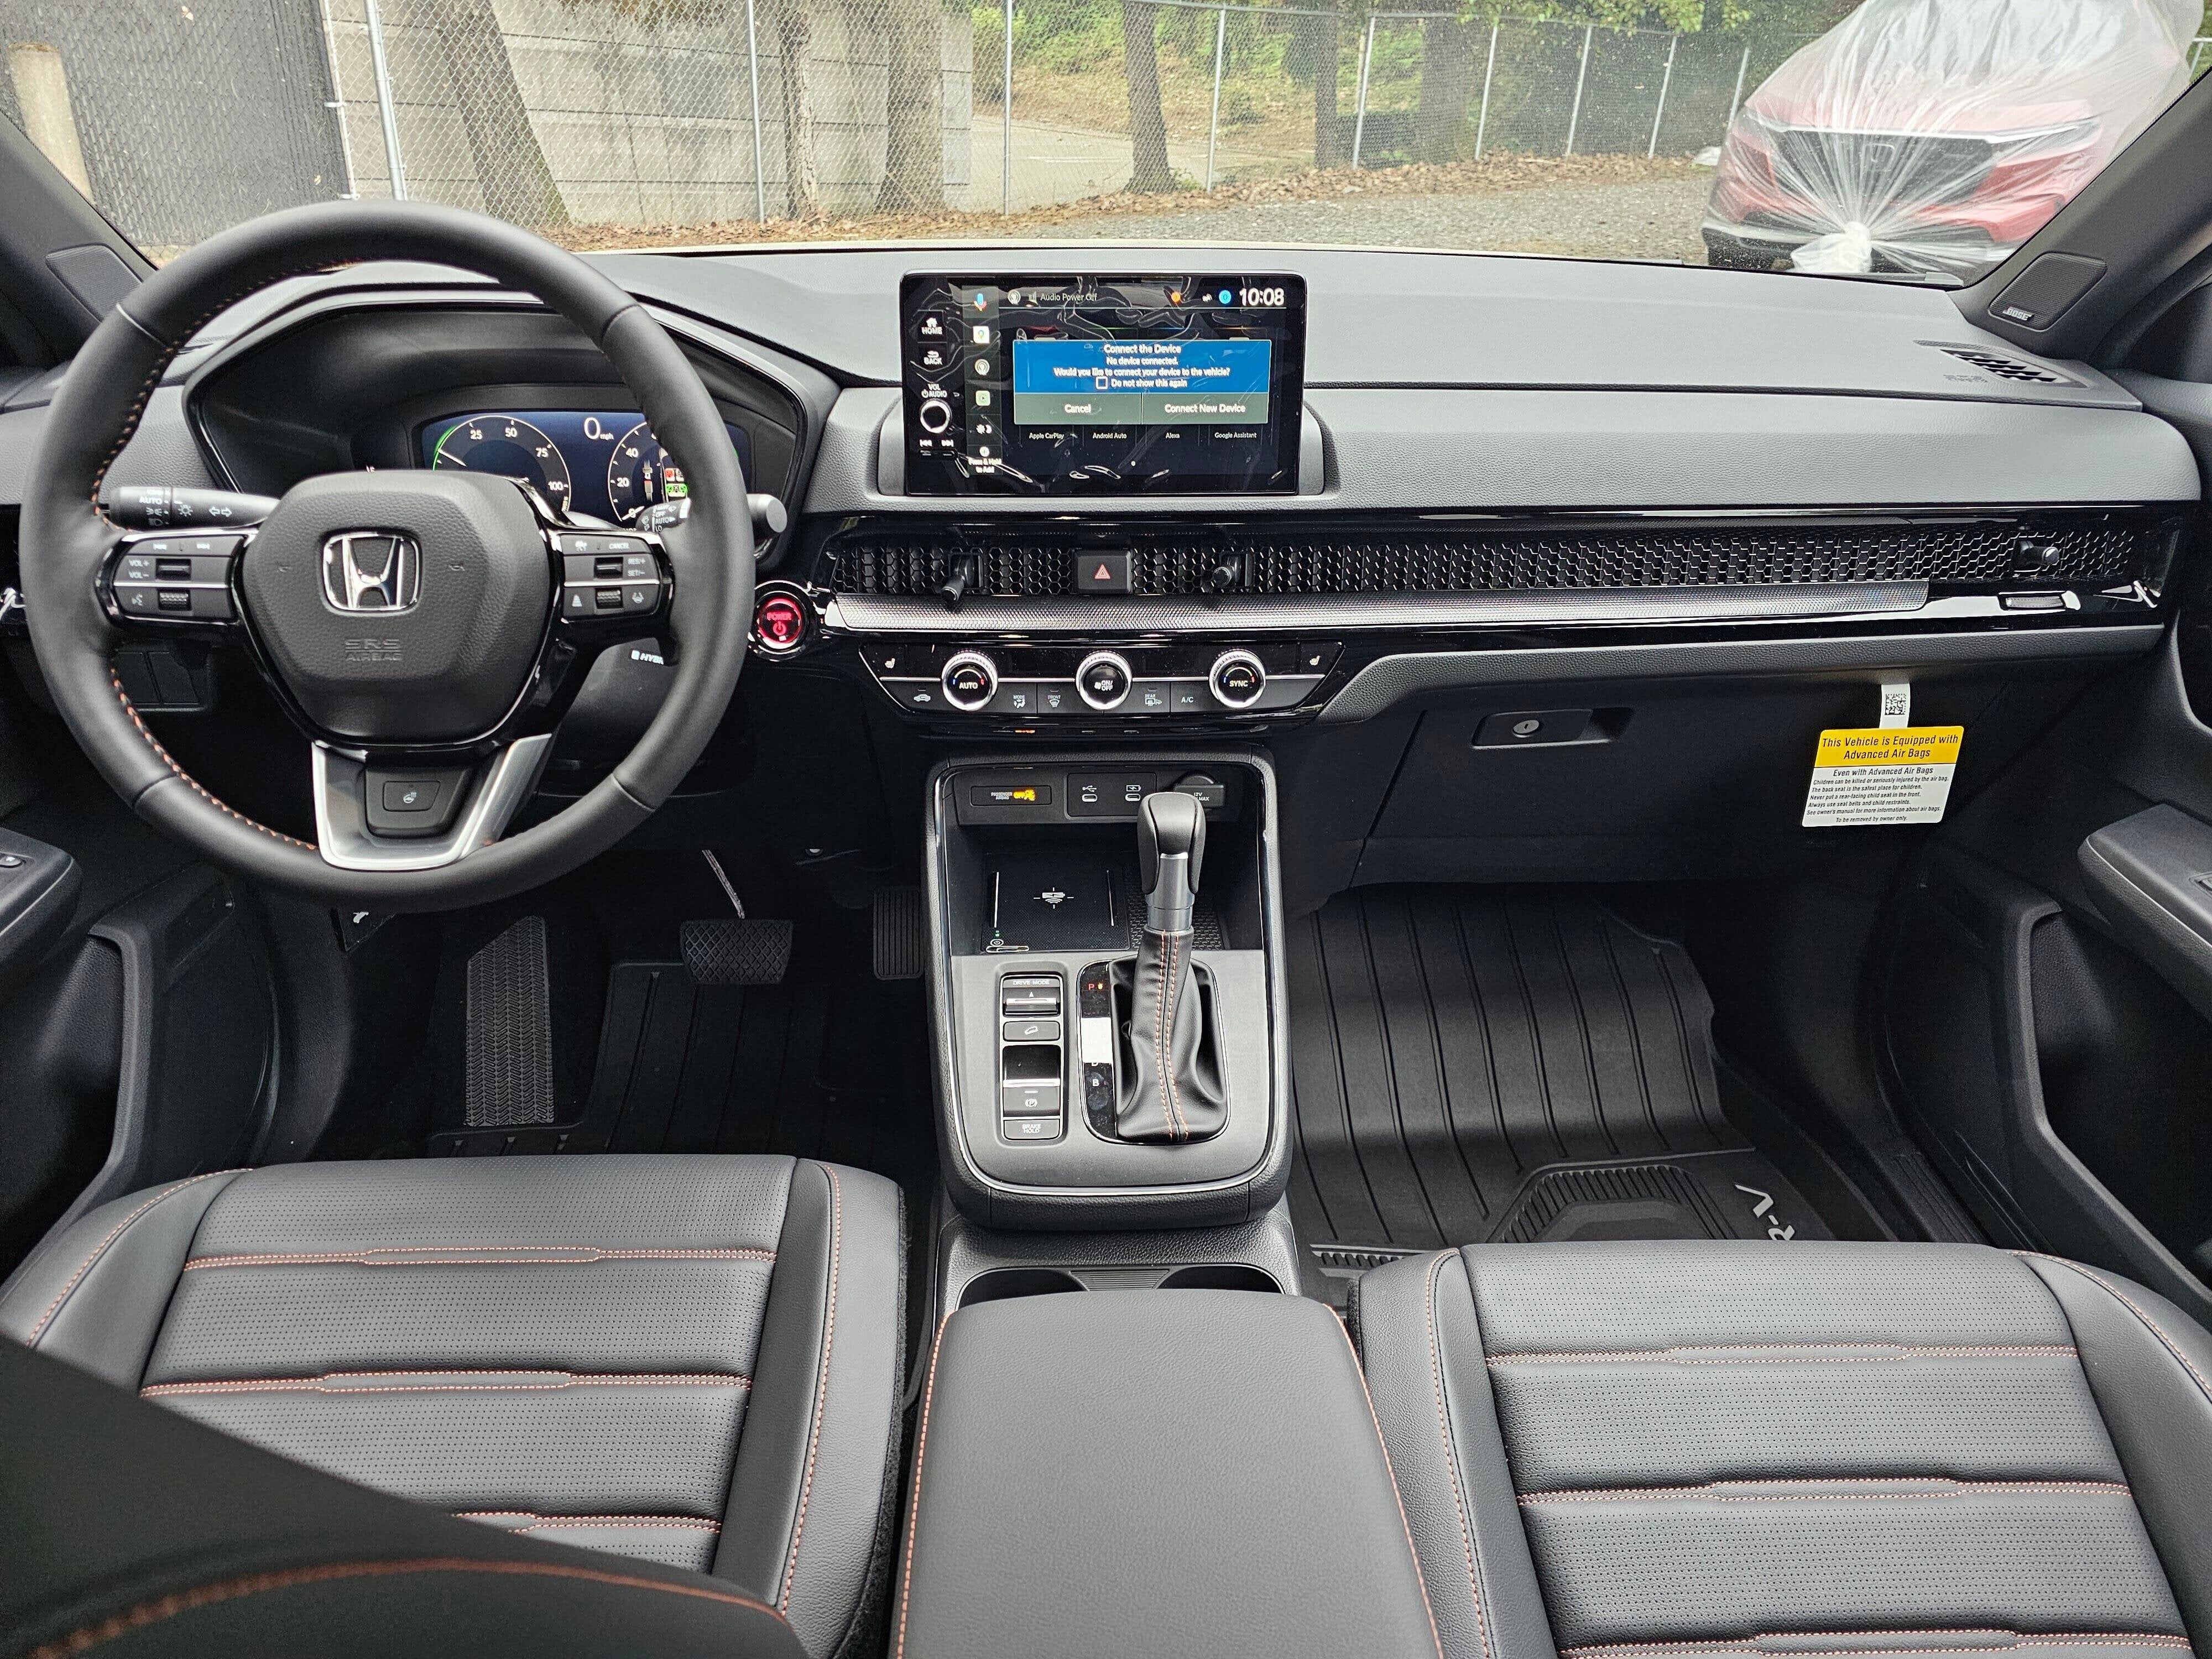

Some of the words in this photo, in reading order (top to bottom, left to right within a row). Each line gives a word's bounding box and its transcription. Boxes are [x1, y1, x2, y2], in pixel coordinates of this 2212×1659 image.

[1062, 293, 1086, 301] Power
[1239, 287, 1285, 306] 10:08
[921, 326, 943, 335] HOME
[1103, 344, 1138, 353] Connect
[1139, 344, 1152, 353] the
[1154, 344, 1181, 353] Device
[924, 357, 943, 365] BACK
[1107, 357, 1118, 365] No
[1119, 357, 1140, 365] device
[1141, 357, 1178, 365] connected.
[1053, 368, 1077, 376] Would
[1078, 369, 1091, 378] you
[1092, 368, 1104, 376] like
[1142, 369, 1157, 378] your
[1159, 368, 1181, 376] device
[1191, 368, 1203, 376] the
[1204, 368, 1230, 376] vehicle?
[1111, 379, 1121, 387] Do
[1135, 379, 1154, 387] show
[1155, 379, 1168, 387] this
[1169, 379, 1187, 388] again
[1064, 404, 1092, 413] Cancel
[1164, 404, 1198, 413] Connect
[1199, 404, 1217, 413] New
[1219, 404, 1246, 413] Device
[505, 428, 518, 437] 50
[584, 418, 601, 440] 0
[470, 430, 483, 440] 25
[535, 447, 549, 457] 75
[625, 448, 639, 458] 40
[548, 482, 564, 491] 100
[617, 477, 629, 487] 20
[138, 496, 163, 505] AUTO
[346, 652, 403, 661] AIRBAG
[1823, 738, 1841, 747] This
[1845, 737, 1879, 746] Vehicle
[1882, 737, 1890, 745] is
[1893, 735, 1936, 746] Equipped
[1939, 734, 1959, 744] with
[1844, 749, 1888, 759] Advanced
[1891, 749, 1906, 758] Air
[1908, 749, 1931, 758] Bags
